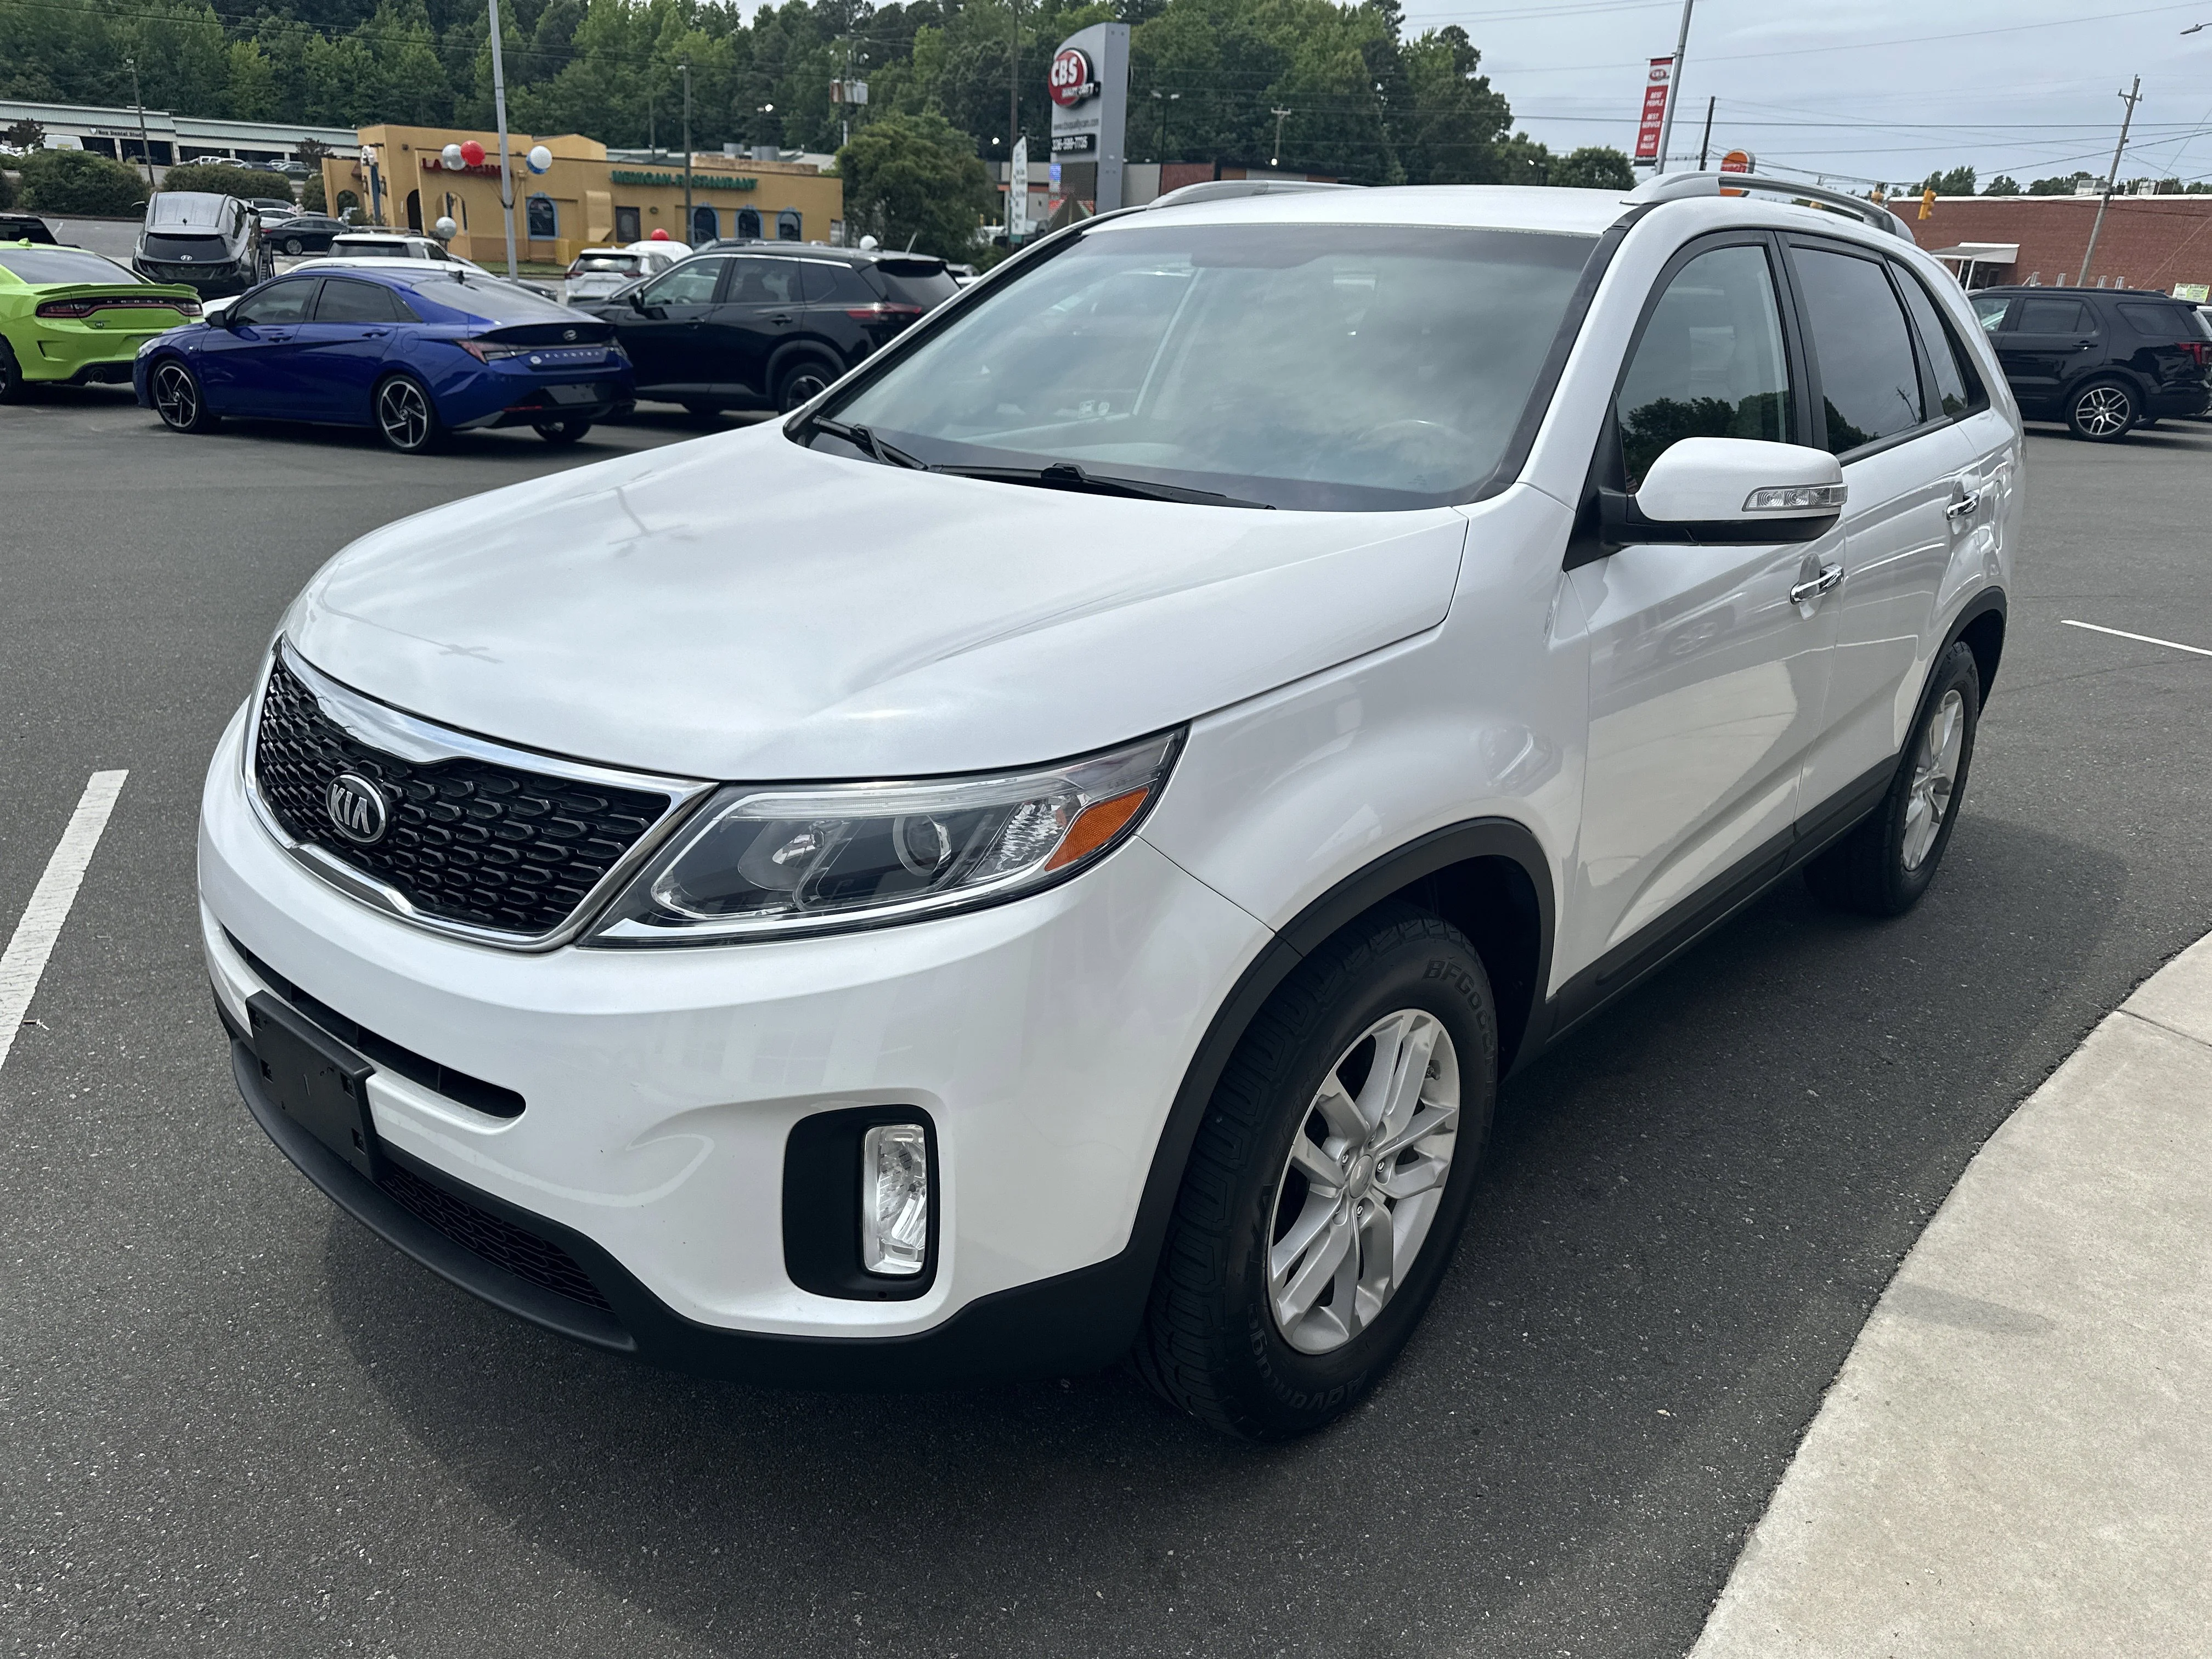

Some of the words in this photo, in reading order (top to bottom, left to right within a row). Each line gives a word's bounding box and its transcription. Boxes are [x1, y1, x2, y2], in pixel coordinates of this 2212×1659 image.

[1051, 55, 1078, 87] CBS
[611, 170, 672, 185] MEXICAN
[674, 173, 759, 190] RSTAURANT
[331, 778, 371, 834] KIA
